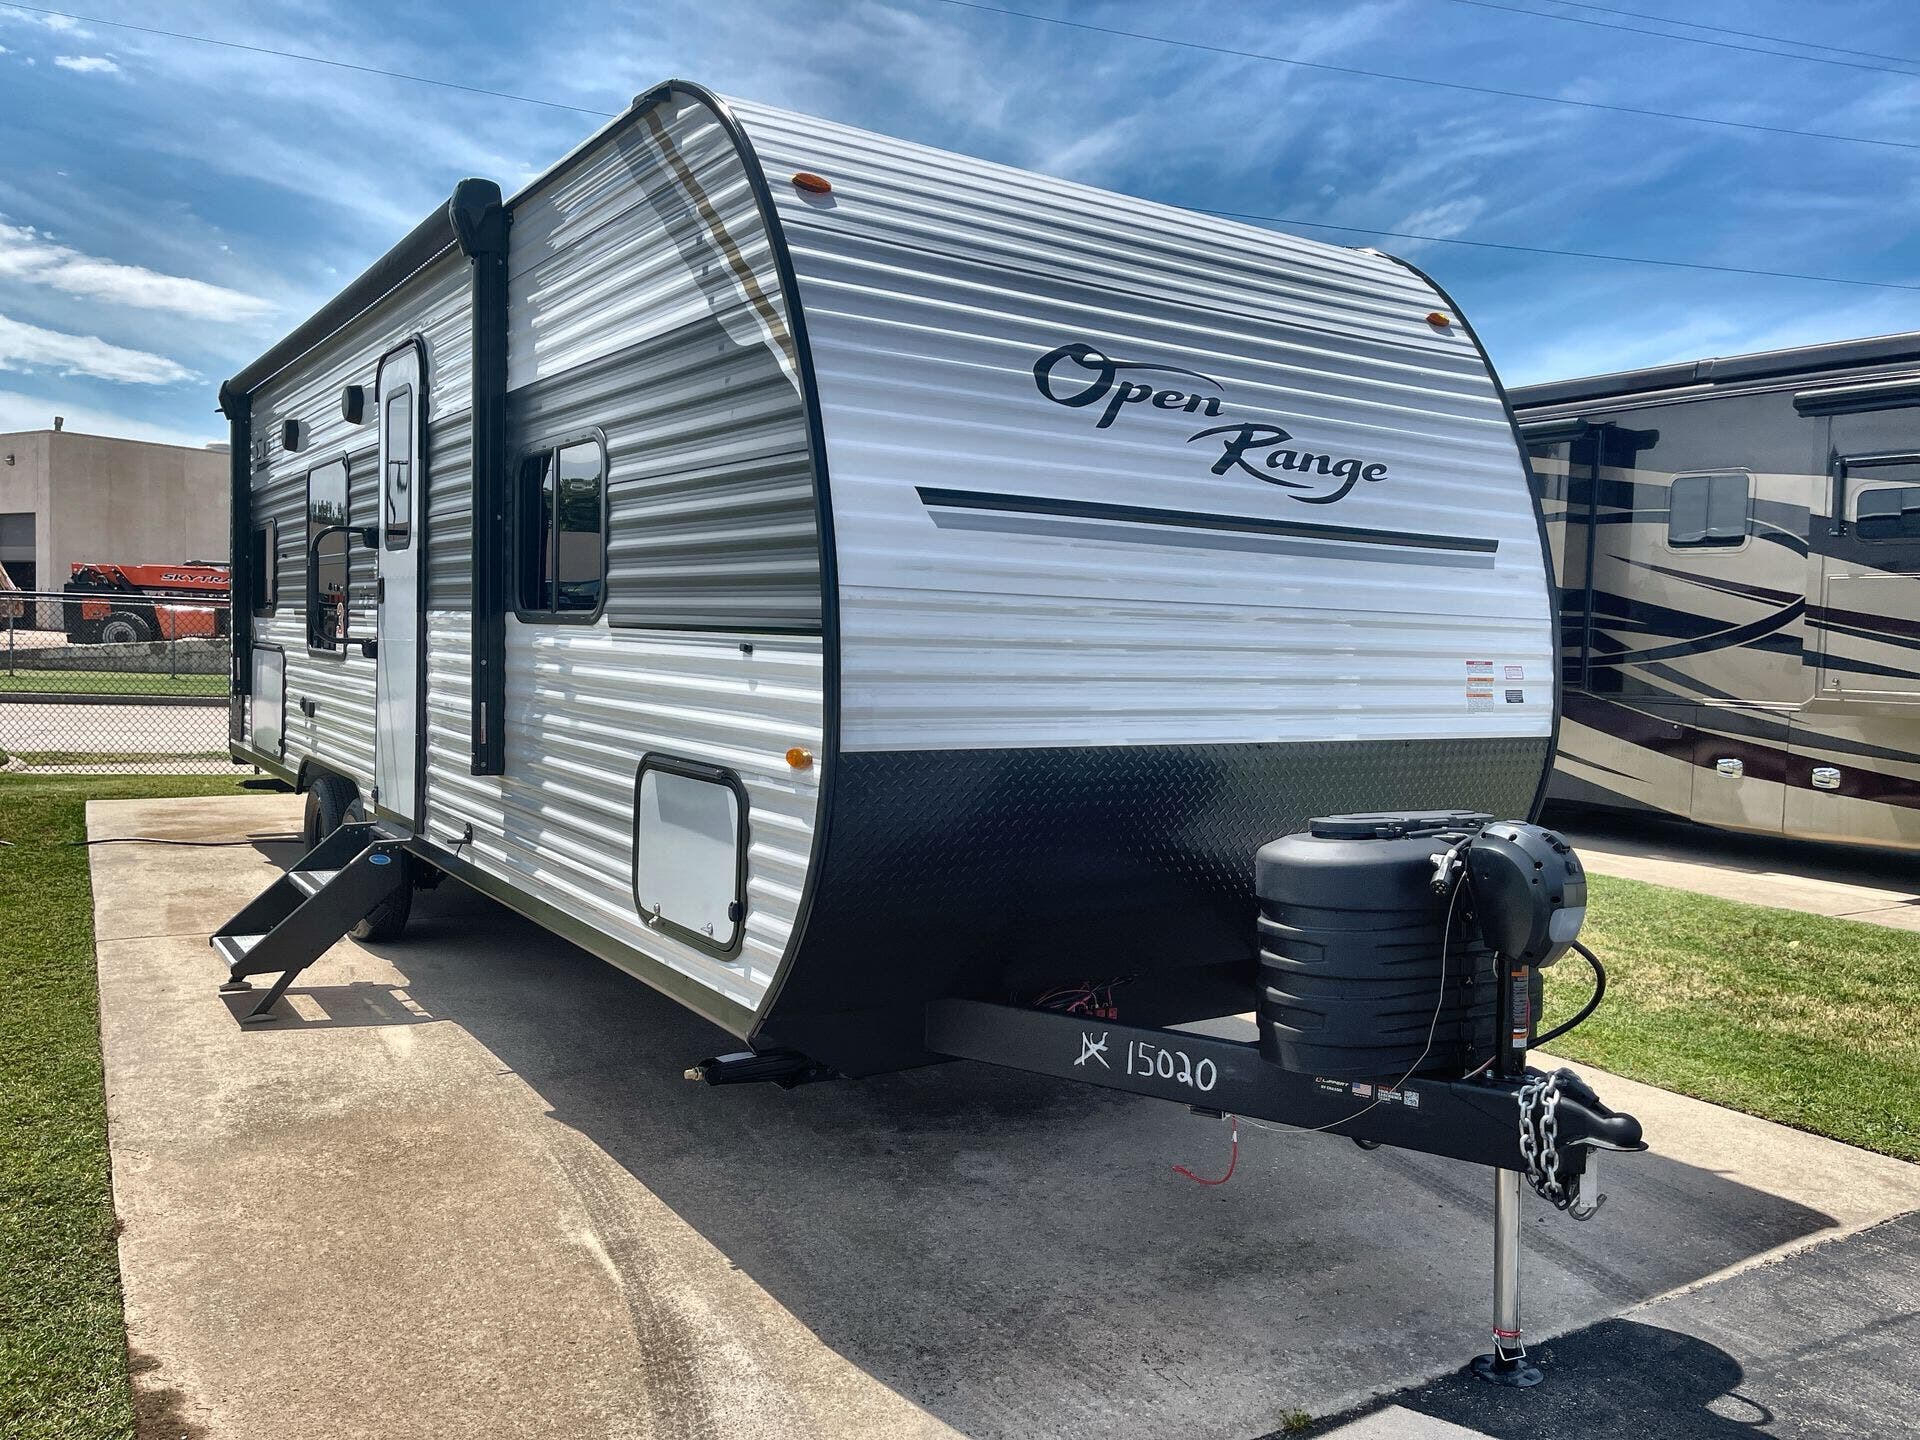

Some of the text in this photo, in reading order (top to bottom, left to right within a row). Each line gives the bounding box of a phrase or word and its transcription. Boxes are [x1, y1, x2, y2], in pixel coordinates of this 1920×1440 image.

[1033, 342, 1225, 429] Open
[1187, 422, 1389, 504] Range
[1127, 1040, 1217, 1091] 15020
